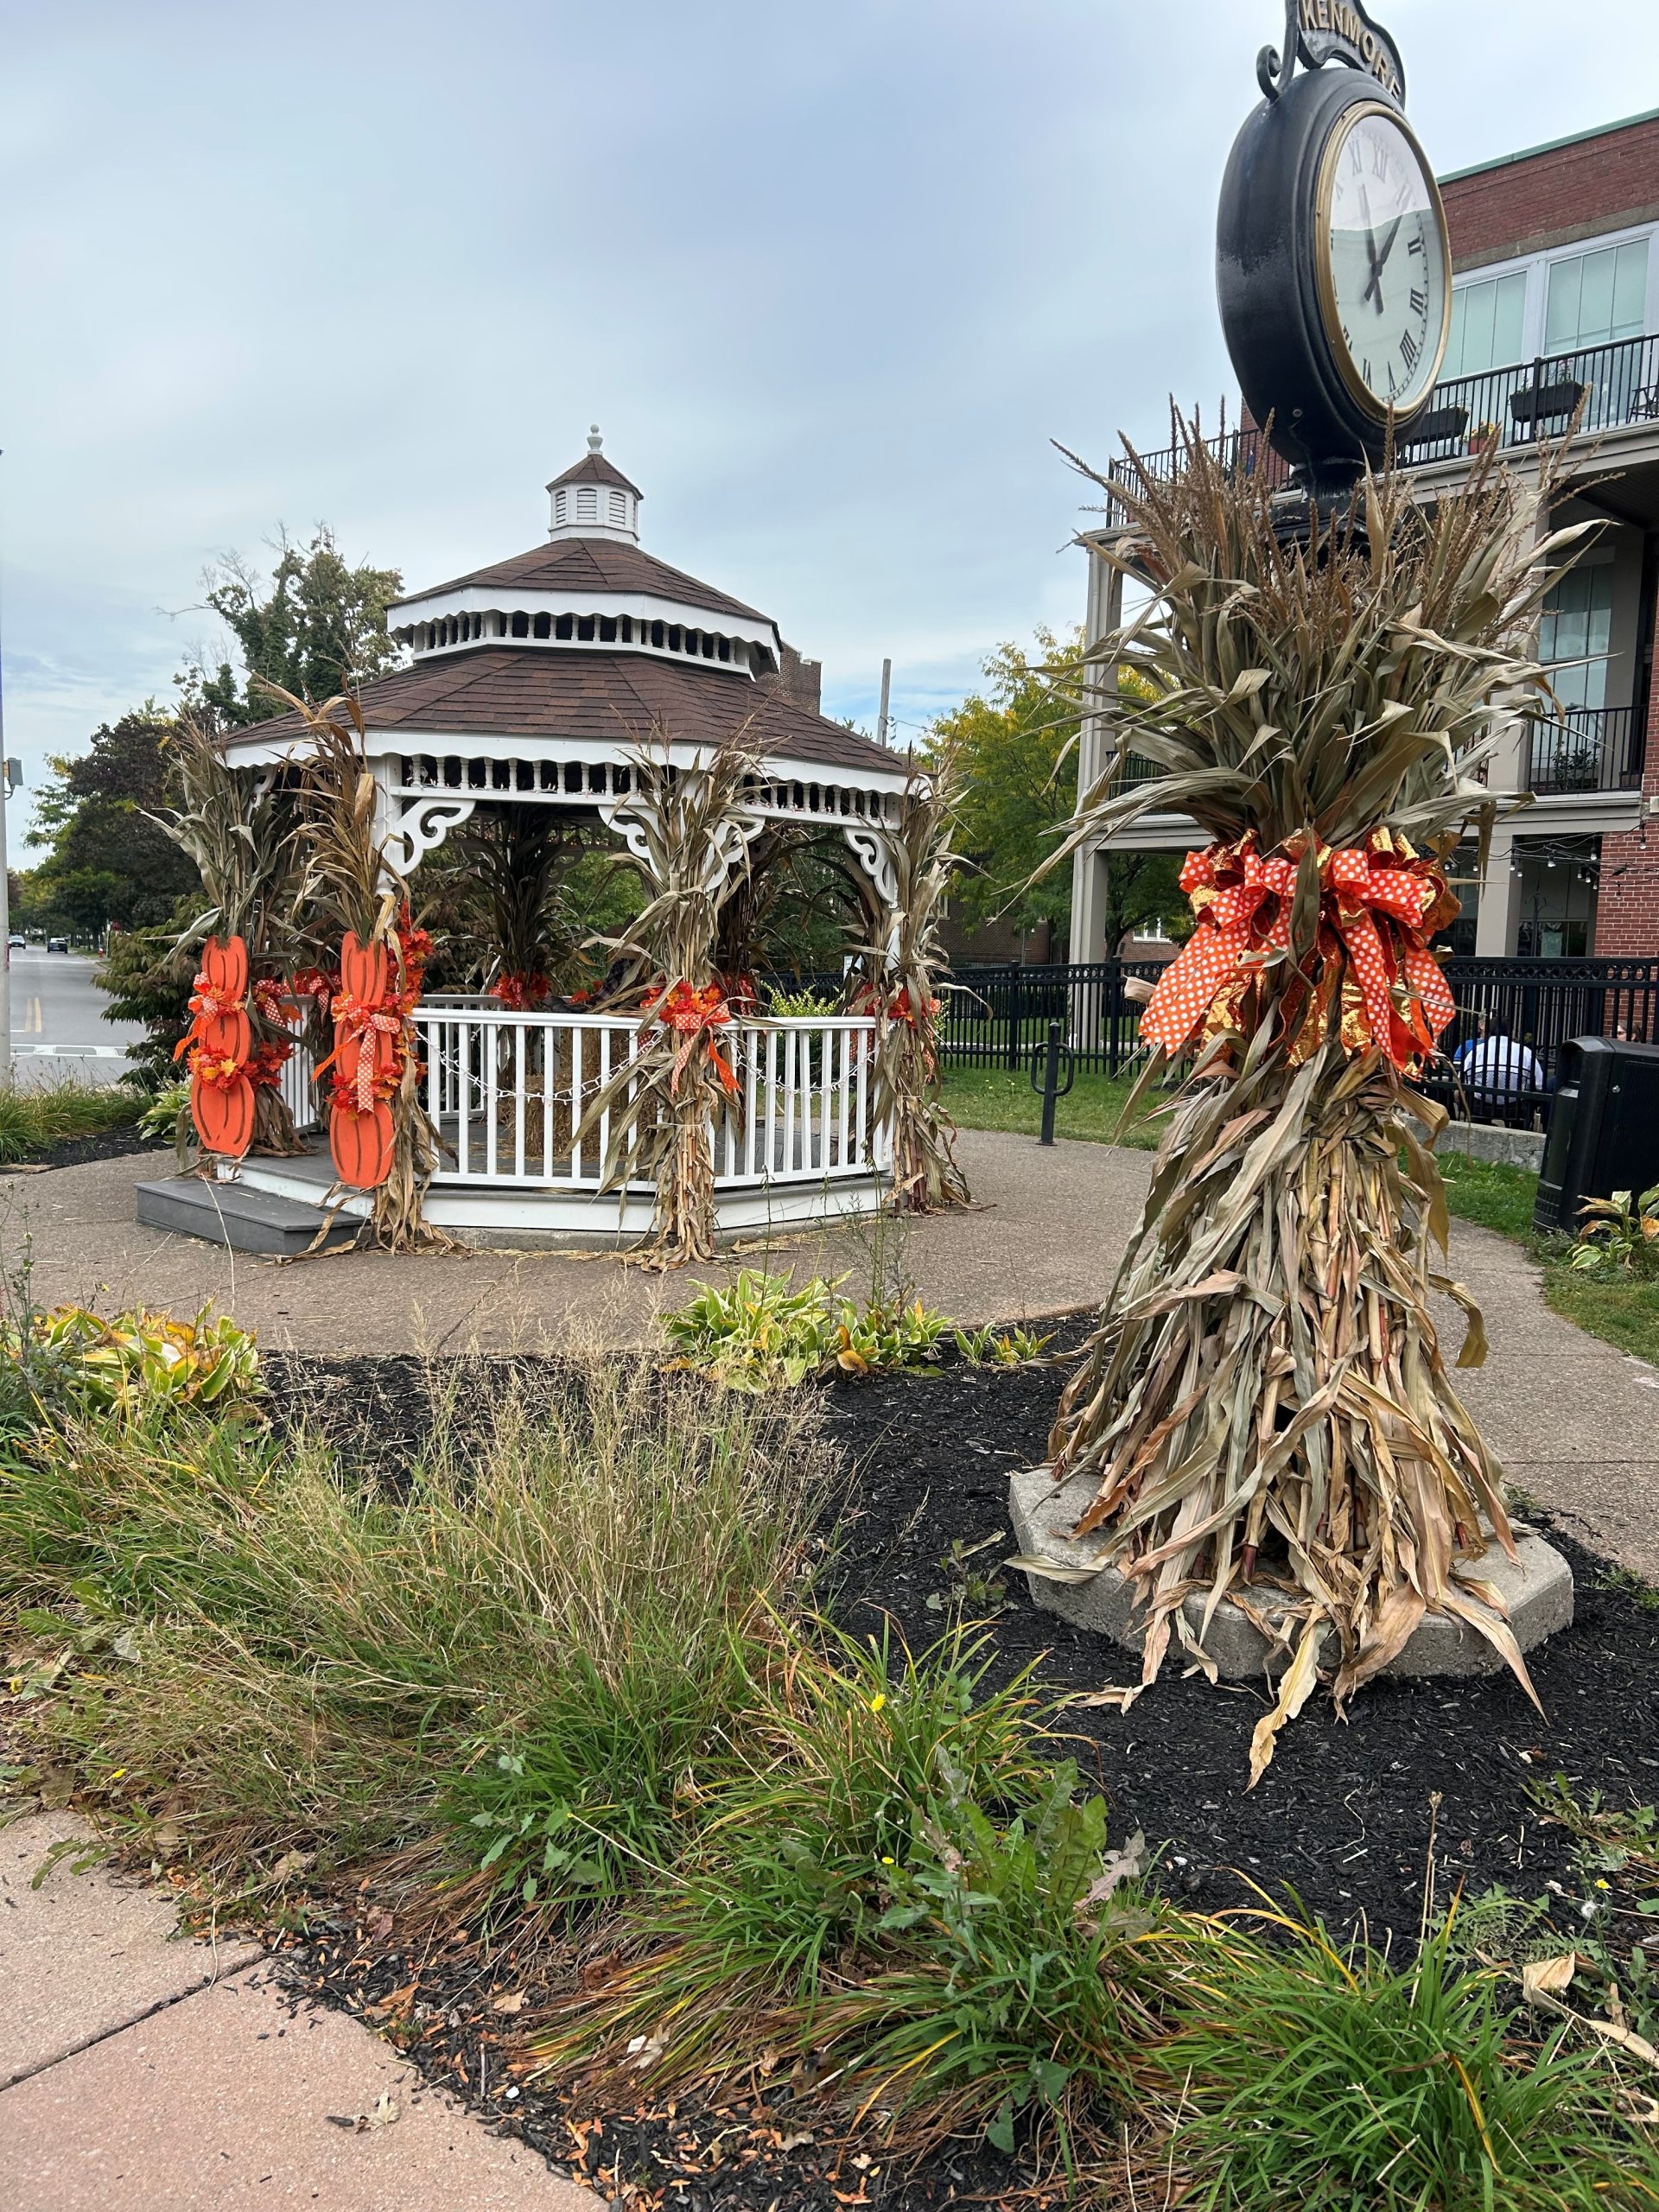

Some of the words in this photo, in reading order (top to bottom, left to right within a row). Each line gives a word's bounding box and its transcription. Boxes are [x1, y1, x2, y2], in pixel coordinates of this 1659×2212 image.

[1408, 236, 1423, 257] II
[1409, 286, 1425, 317] III
[1399, 327, 1417, 372] IIII
[1388, 360, 1397, 393] V
